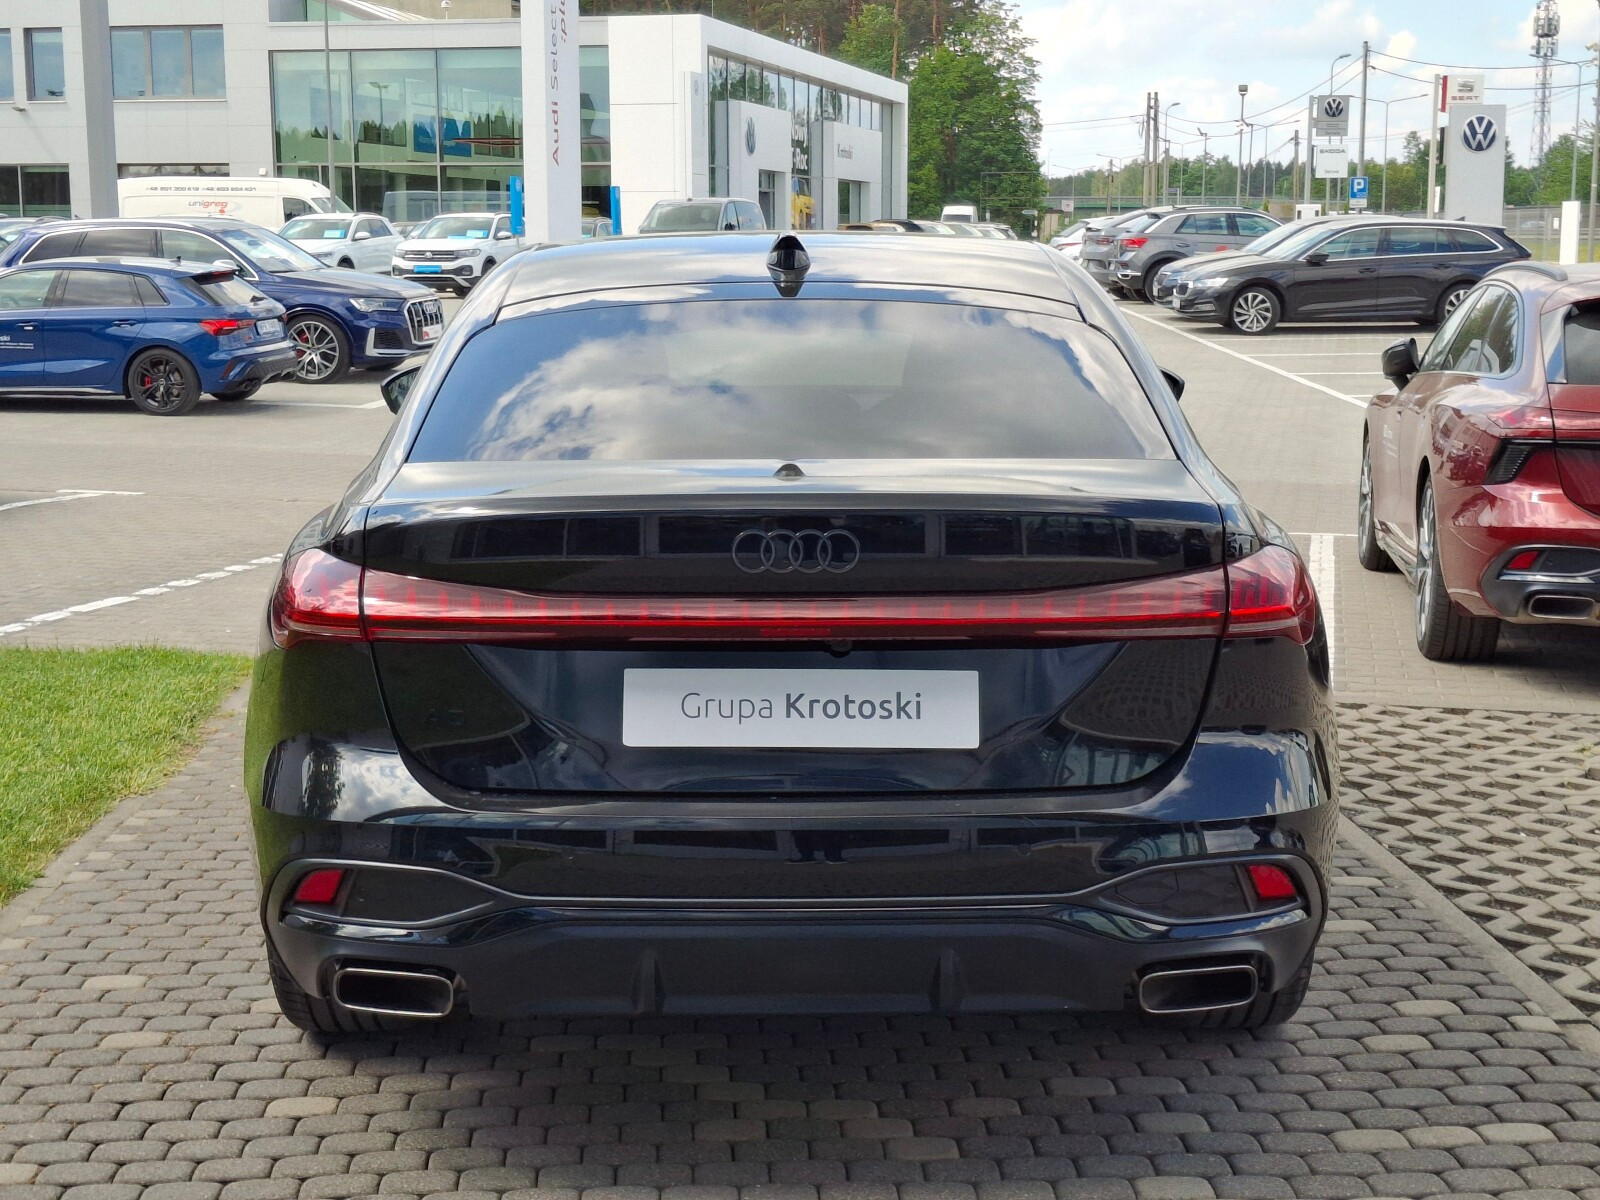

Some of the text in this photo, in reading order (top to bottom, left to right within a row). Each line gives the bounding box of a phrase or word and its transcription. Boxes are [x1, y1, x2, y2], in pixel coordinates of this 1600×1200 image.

[550, 4, 559, 91] Select
[1354, 178, 1365, 193] P
[681, 691, 922, 725] Grupa Krotoski
